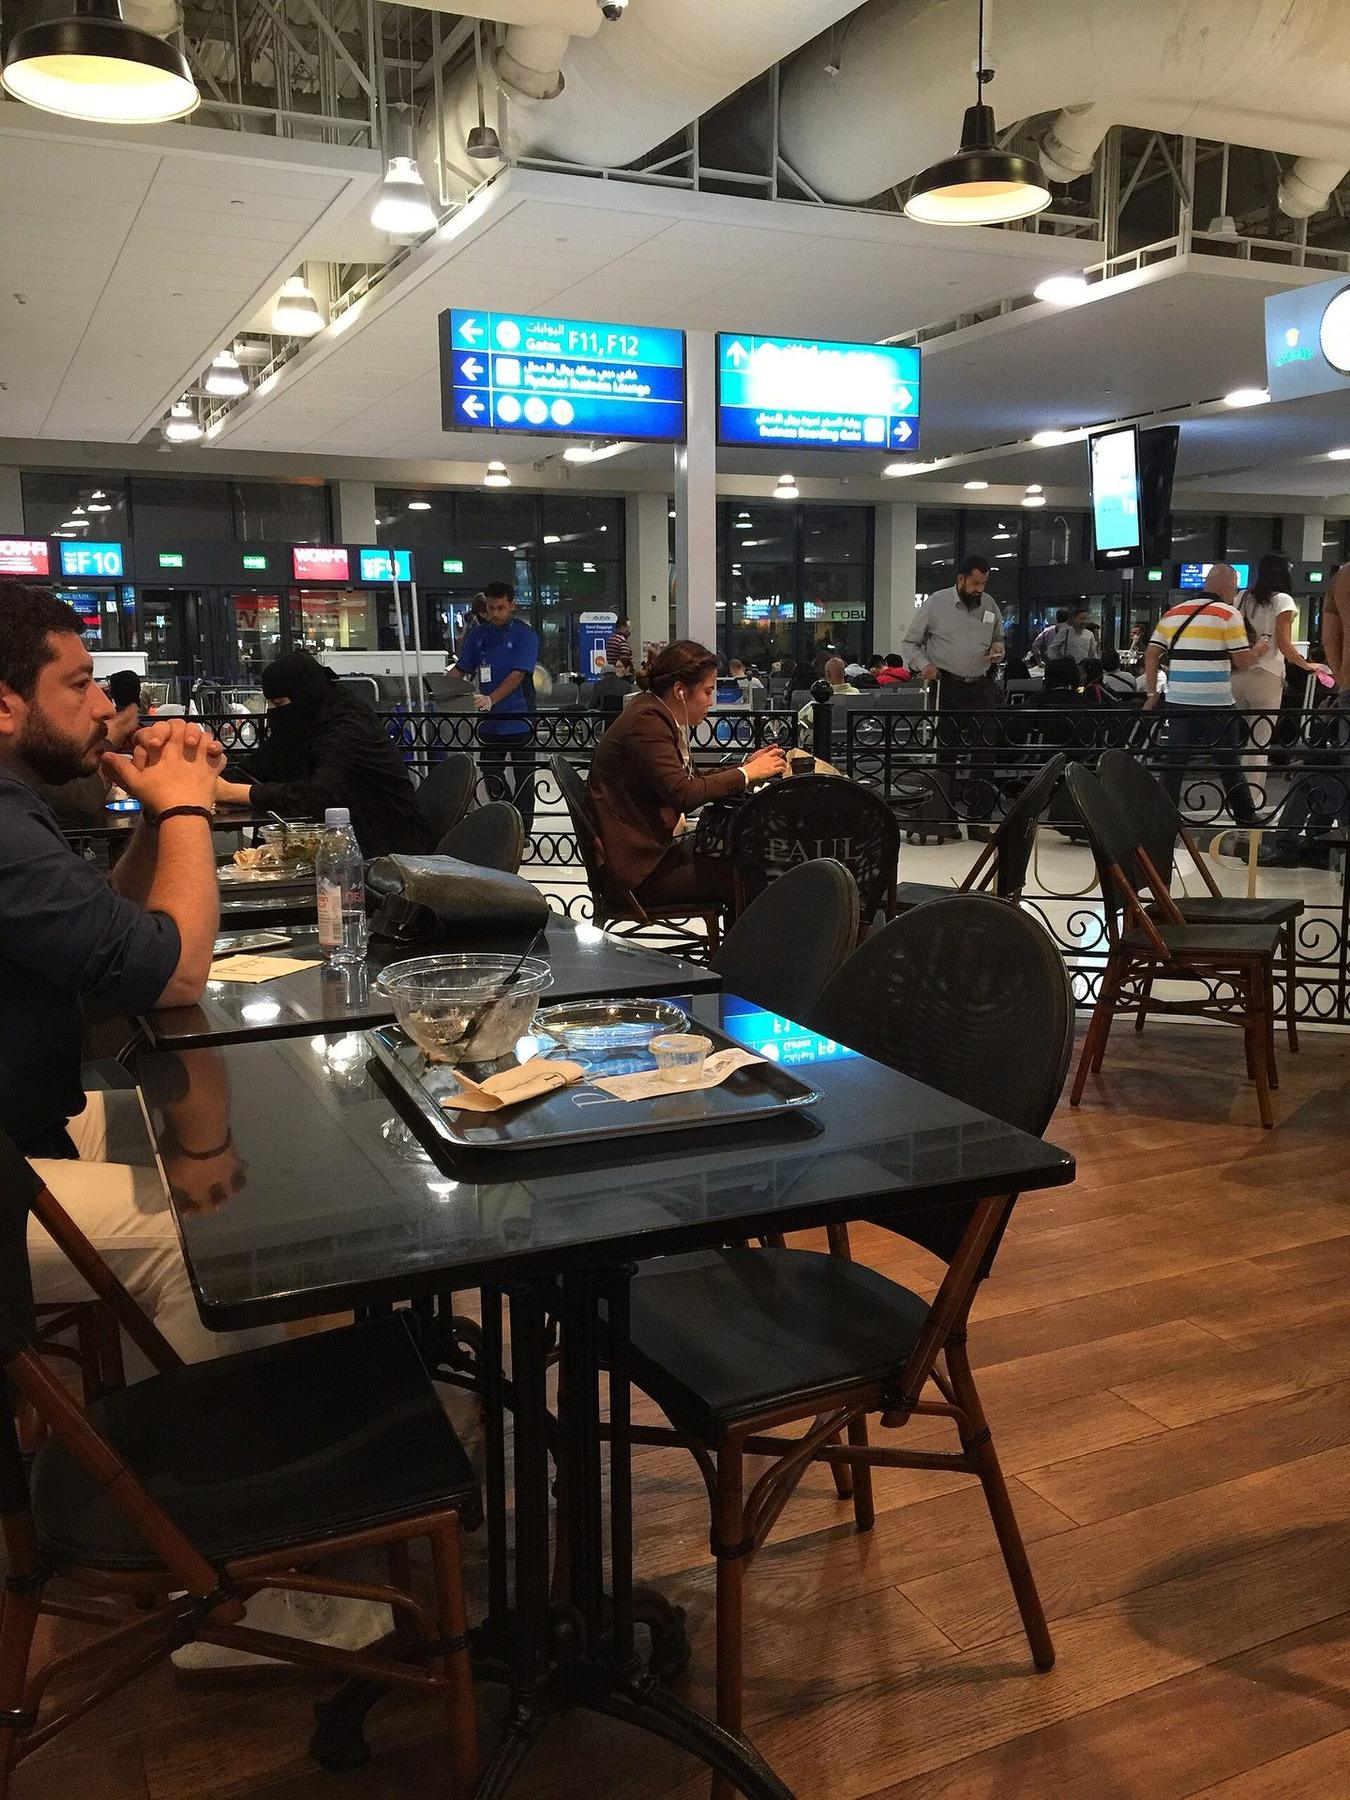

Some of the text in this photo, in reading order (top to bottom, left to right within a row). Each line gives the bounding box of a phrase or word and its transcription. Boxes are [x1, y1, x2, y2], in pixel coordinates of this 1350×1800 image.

[526, 331, 640, 357] Gates F11, F12
[613, 381, 651, 396] Lounge
[78, 551, 120, 574] F10
[768, 837, 863, 861] PAUL
